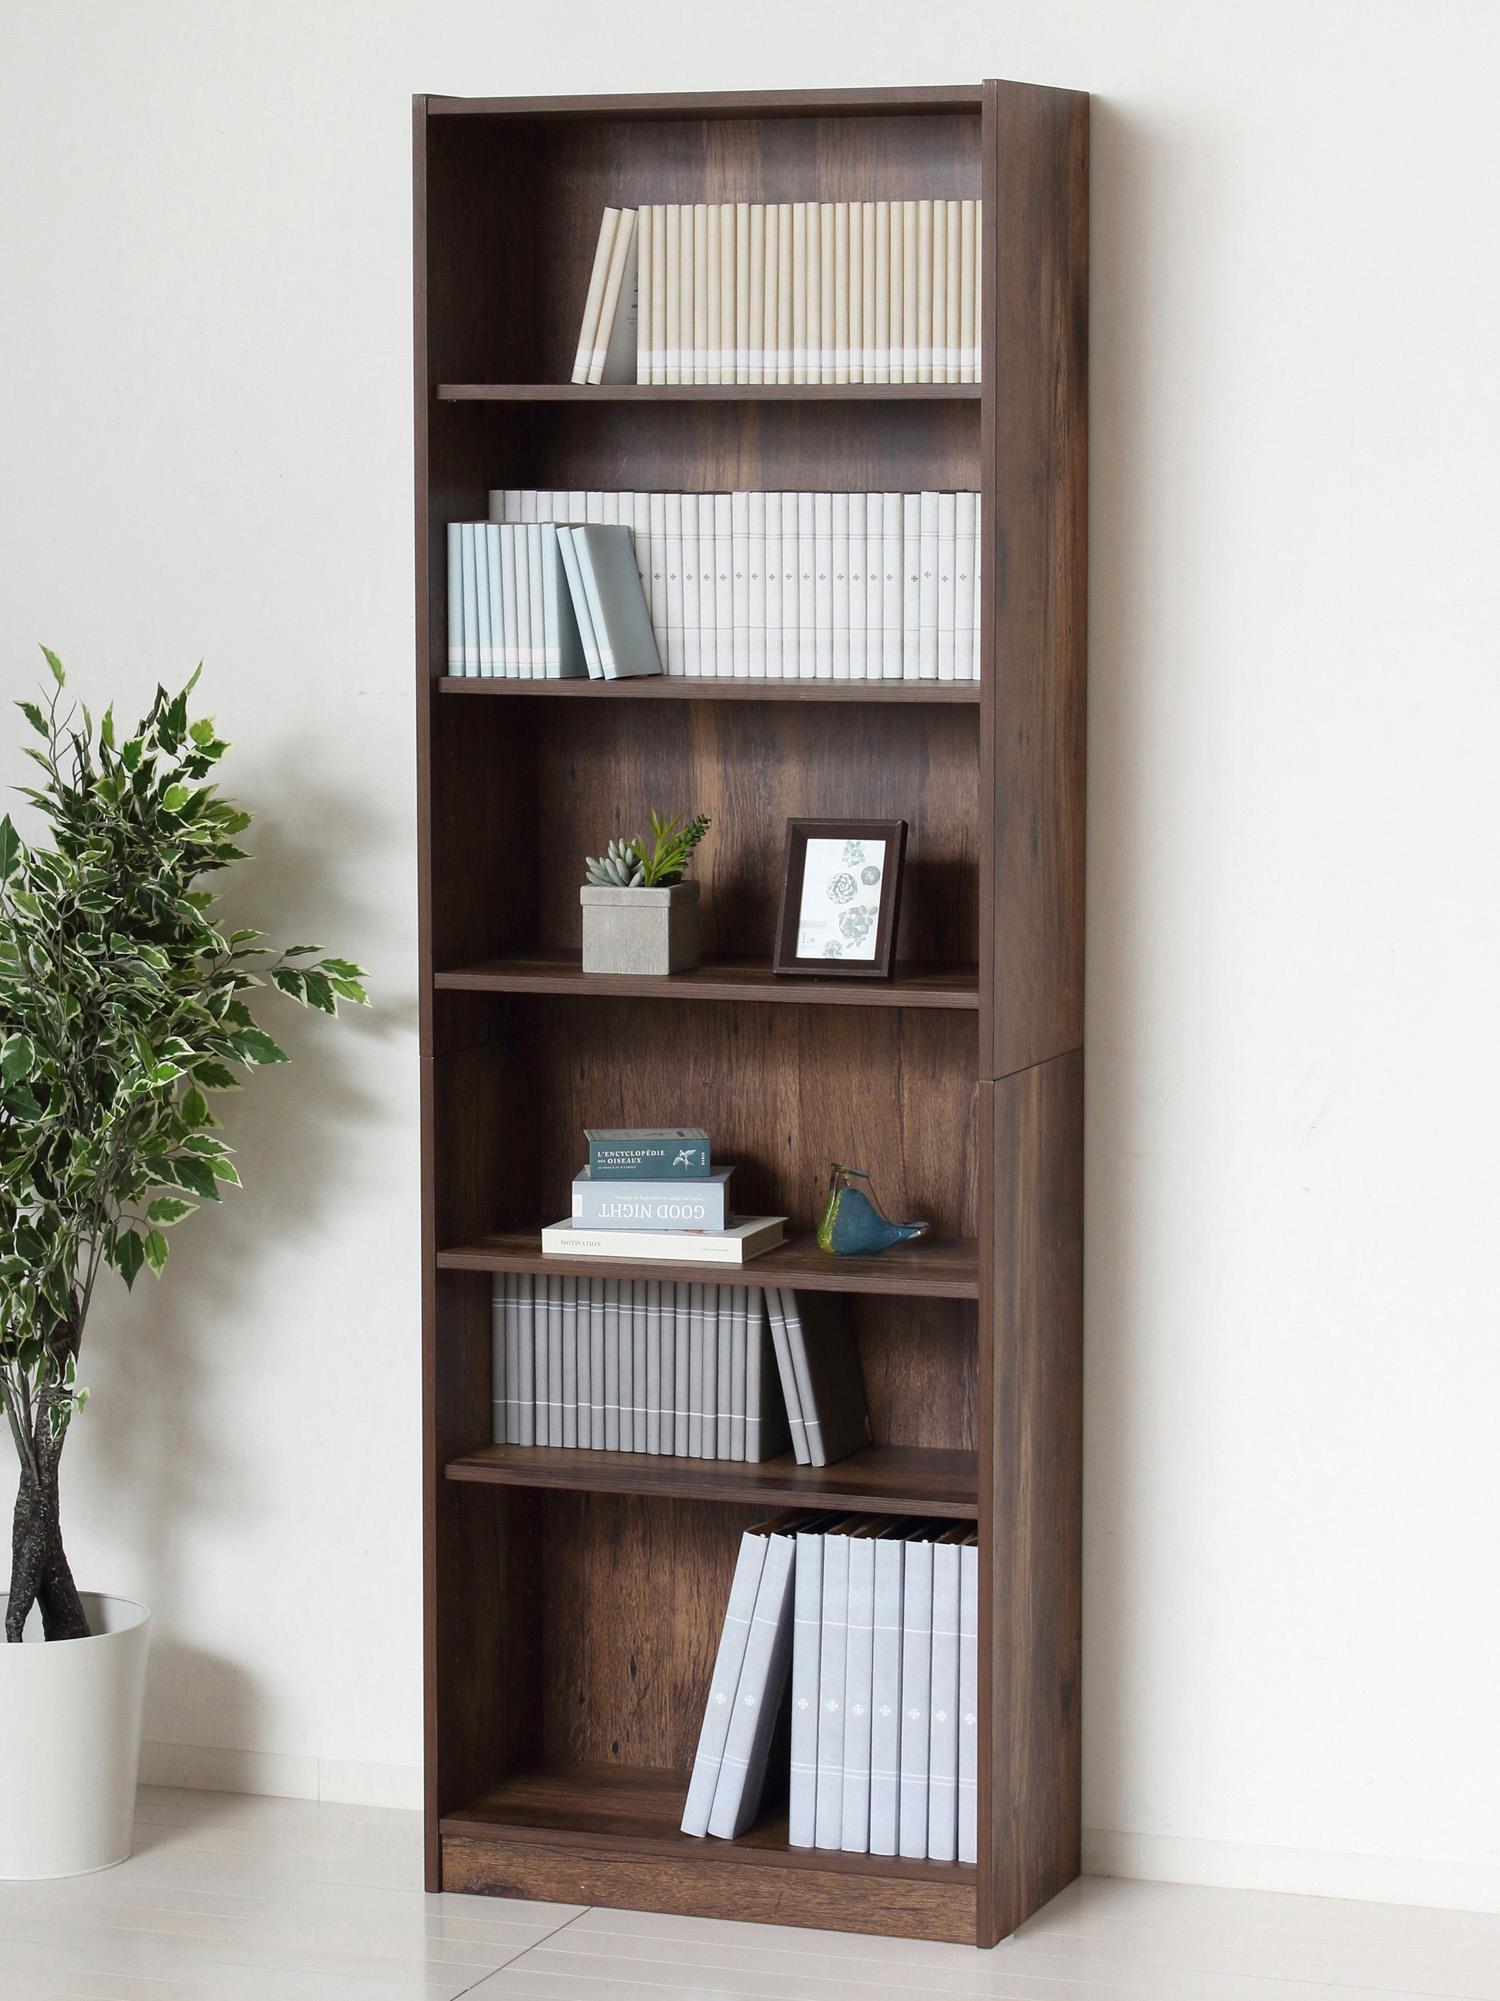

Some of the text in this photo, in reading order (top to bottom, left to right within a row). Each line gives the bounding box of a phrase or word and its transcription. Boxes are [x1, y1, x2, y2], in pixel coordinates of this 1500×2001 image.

[607, 1157, 642, 1165] OISEAUX
[598, 1204, 705, 1219] GOOD NIGHT
[560, 1239, 602, 1248] MOTIVATION
